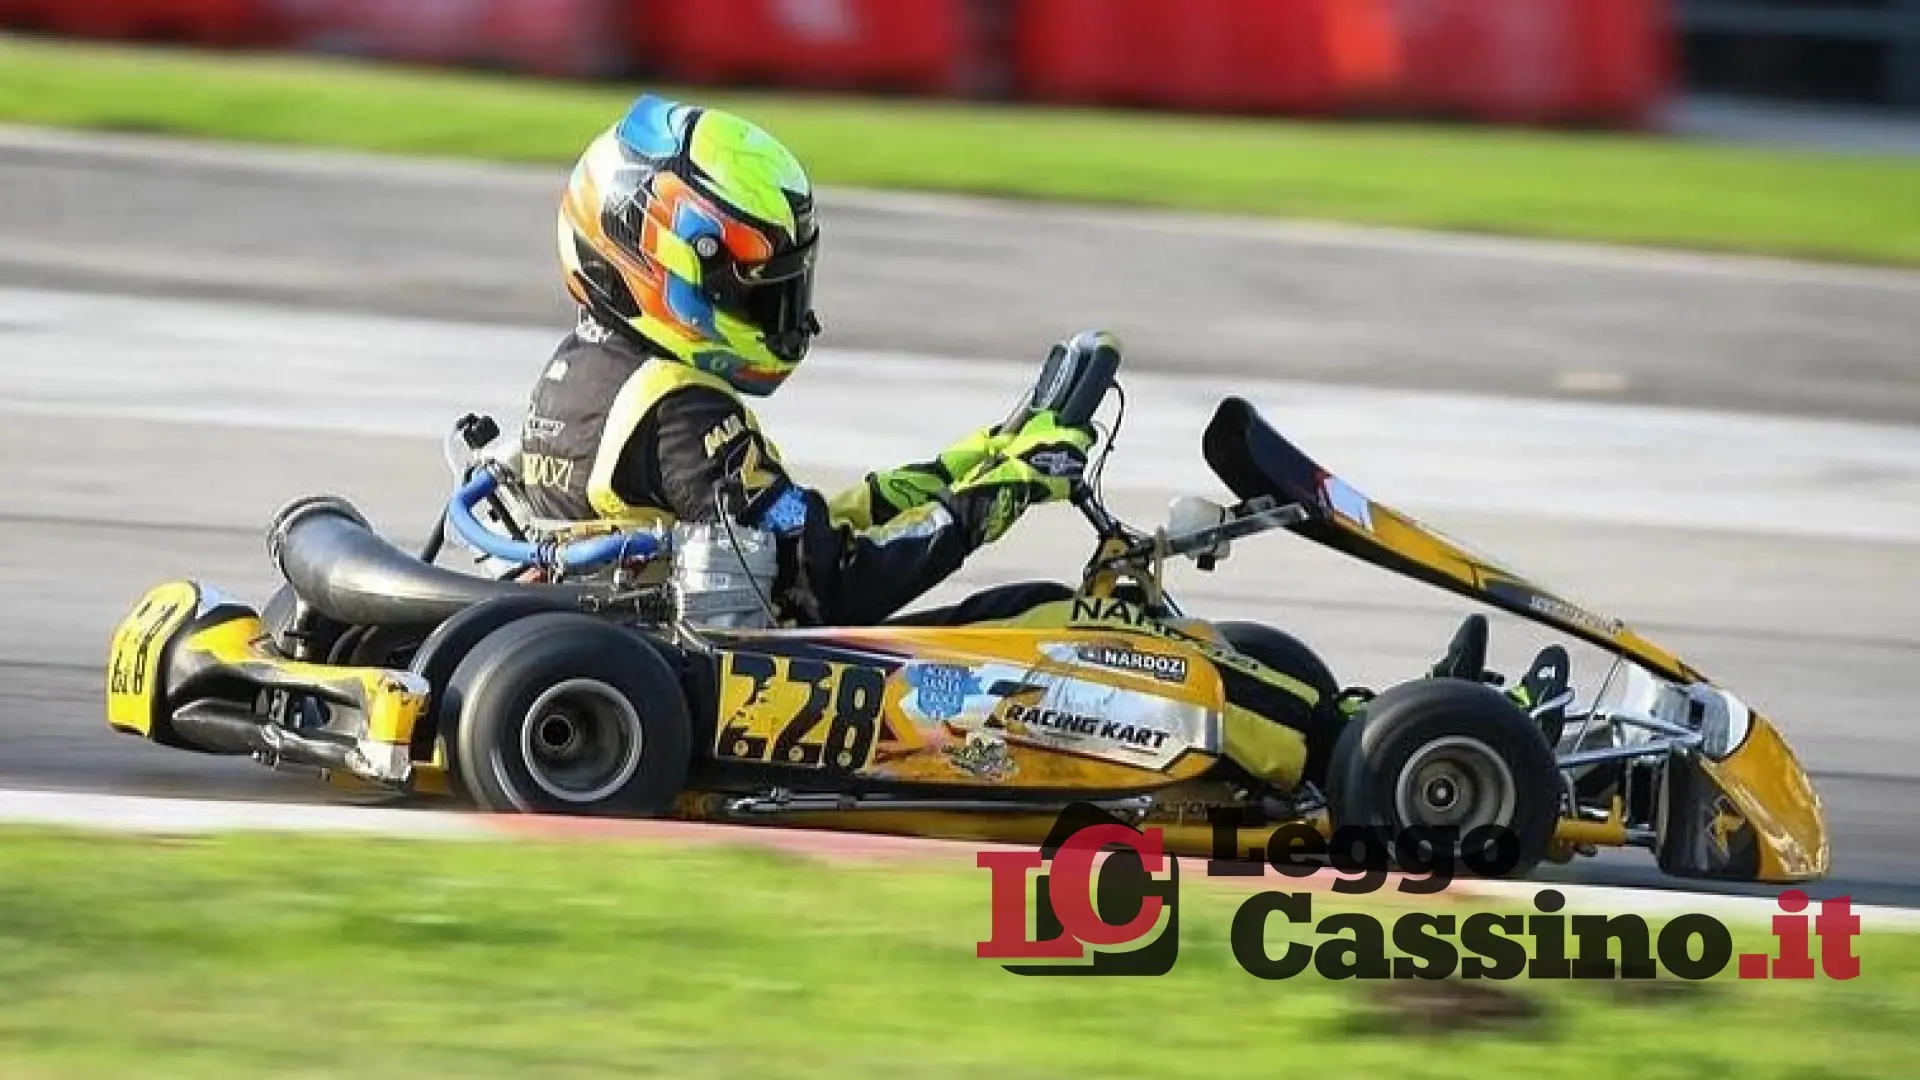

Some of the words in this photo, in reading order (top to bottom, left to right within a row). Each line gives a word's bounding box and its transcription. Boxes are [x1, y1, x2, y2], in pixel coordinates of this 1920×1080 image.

[719, 652, 884, 771] 228
[1005, 703, 1100, 735] RACING
[1100, 719, 1170, 749] KART
